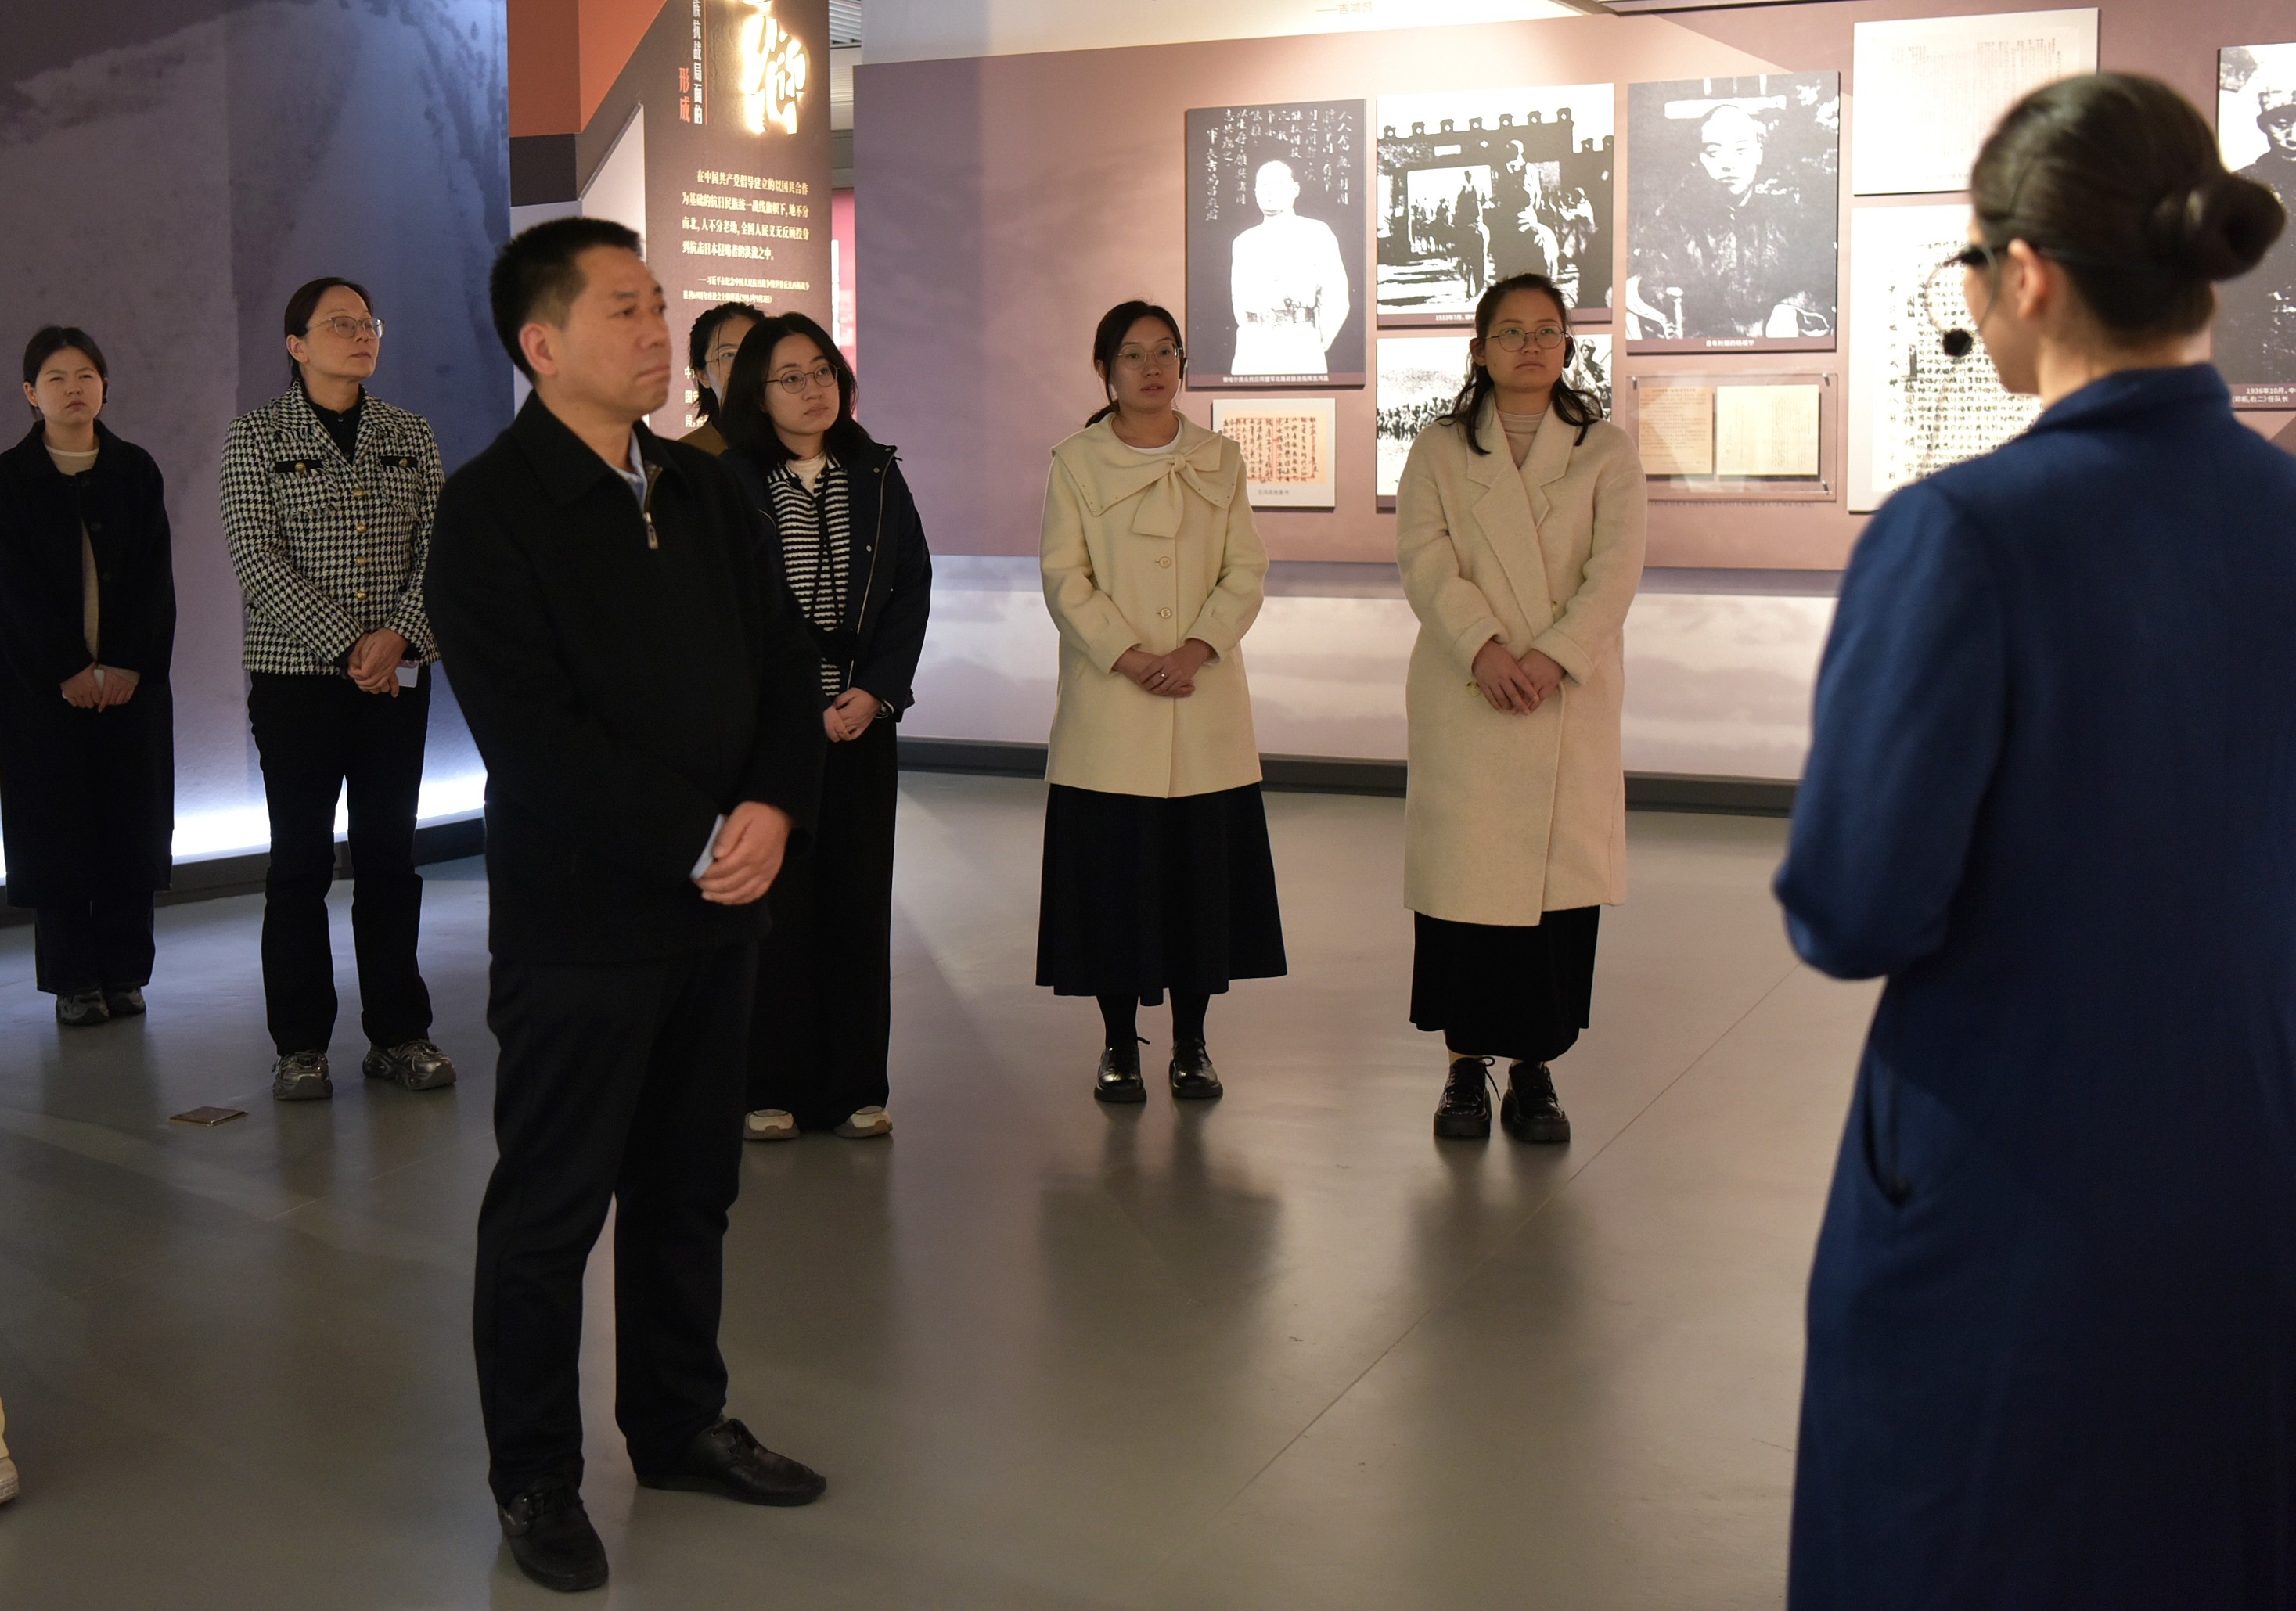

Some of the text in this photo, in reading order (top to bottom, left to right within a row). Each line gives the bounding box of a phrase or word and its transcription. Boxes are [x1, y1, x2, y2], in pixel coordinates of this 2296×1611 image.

[679, 67, 690, 123] 形成
[697, 169, 809, 196] 在中国共产党倡导建立的以国共合作
[682, 240, 774, 261] 到抗击日本侵略者的洪流之中。
